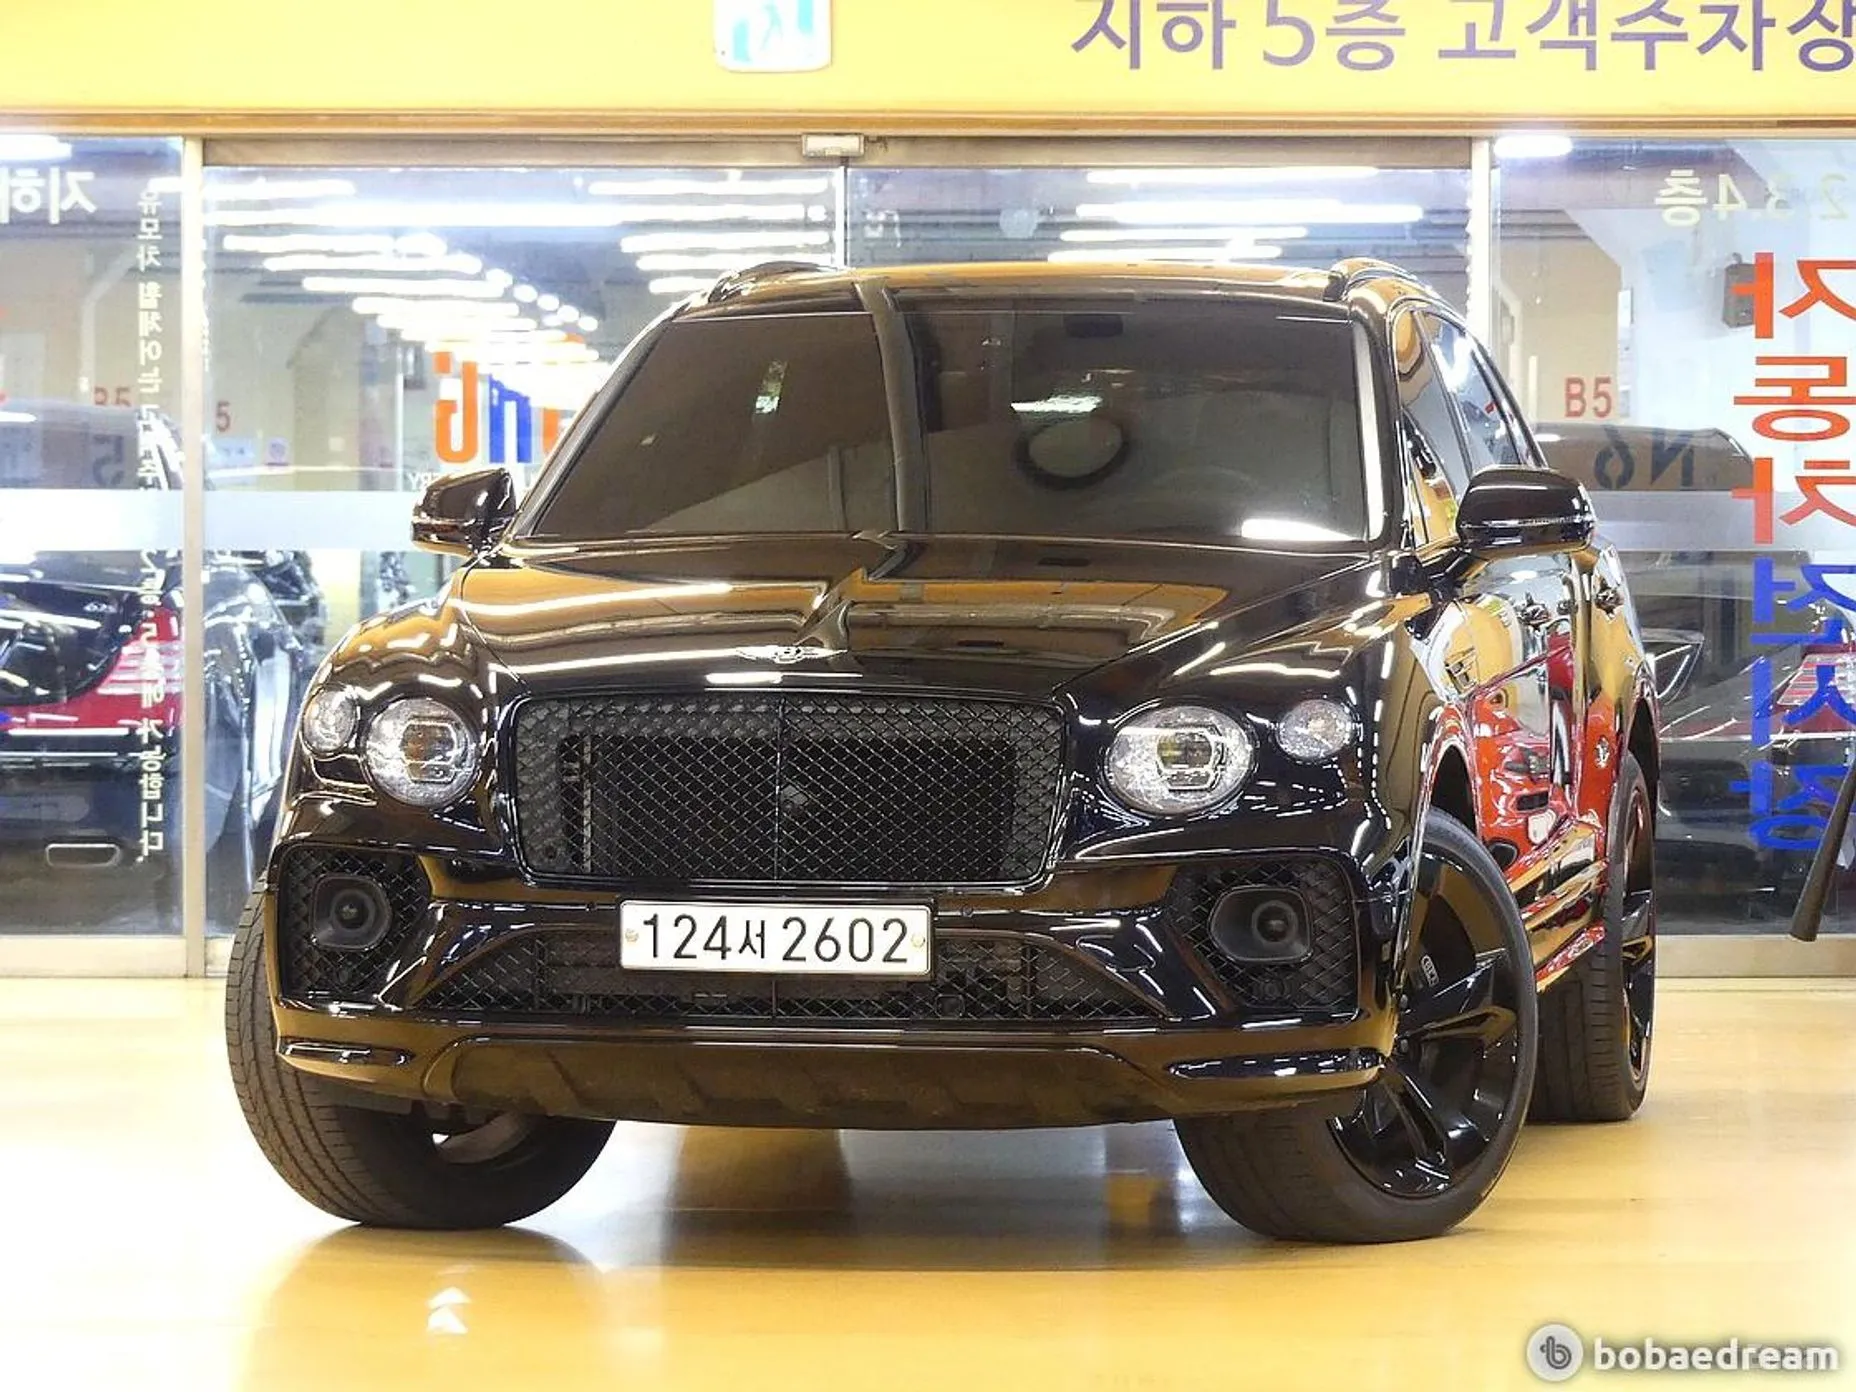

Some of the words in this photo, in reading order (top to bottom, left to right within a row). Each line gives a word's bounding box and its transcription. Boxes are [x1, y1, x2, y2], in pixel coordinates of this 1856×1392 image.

[1564, 377, 1612, 418] B5
[643, 913, 765, 960] 124서
[782, 916, 907, 963] 2602
